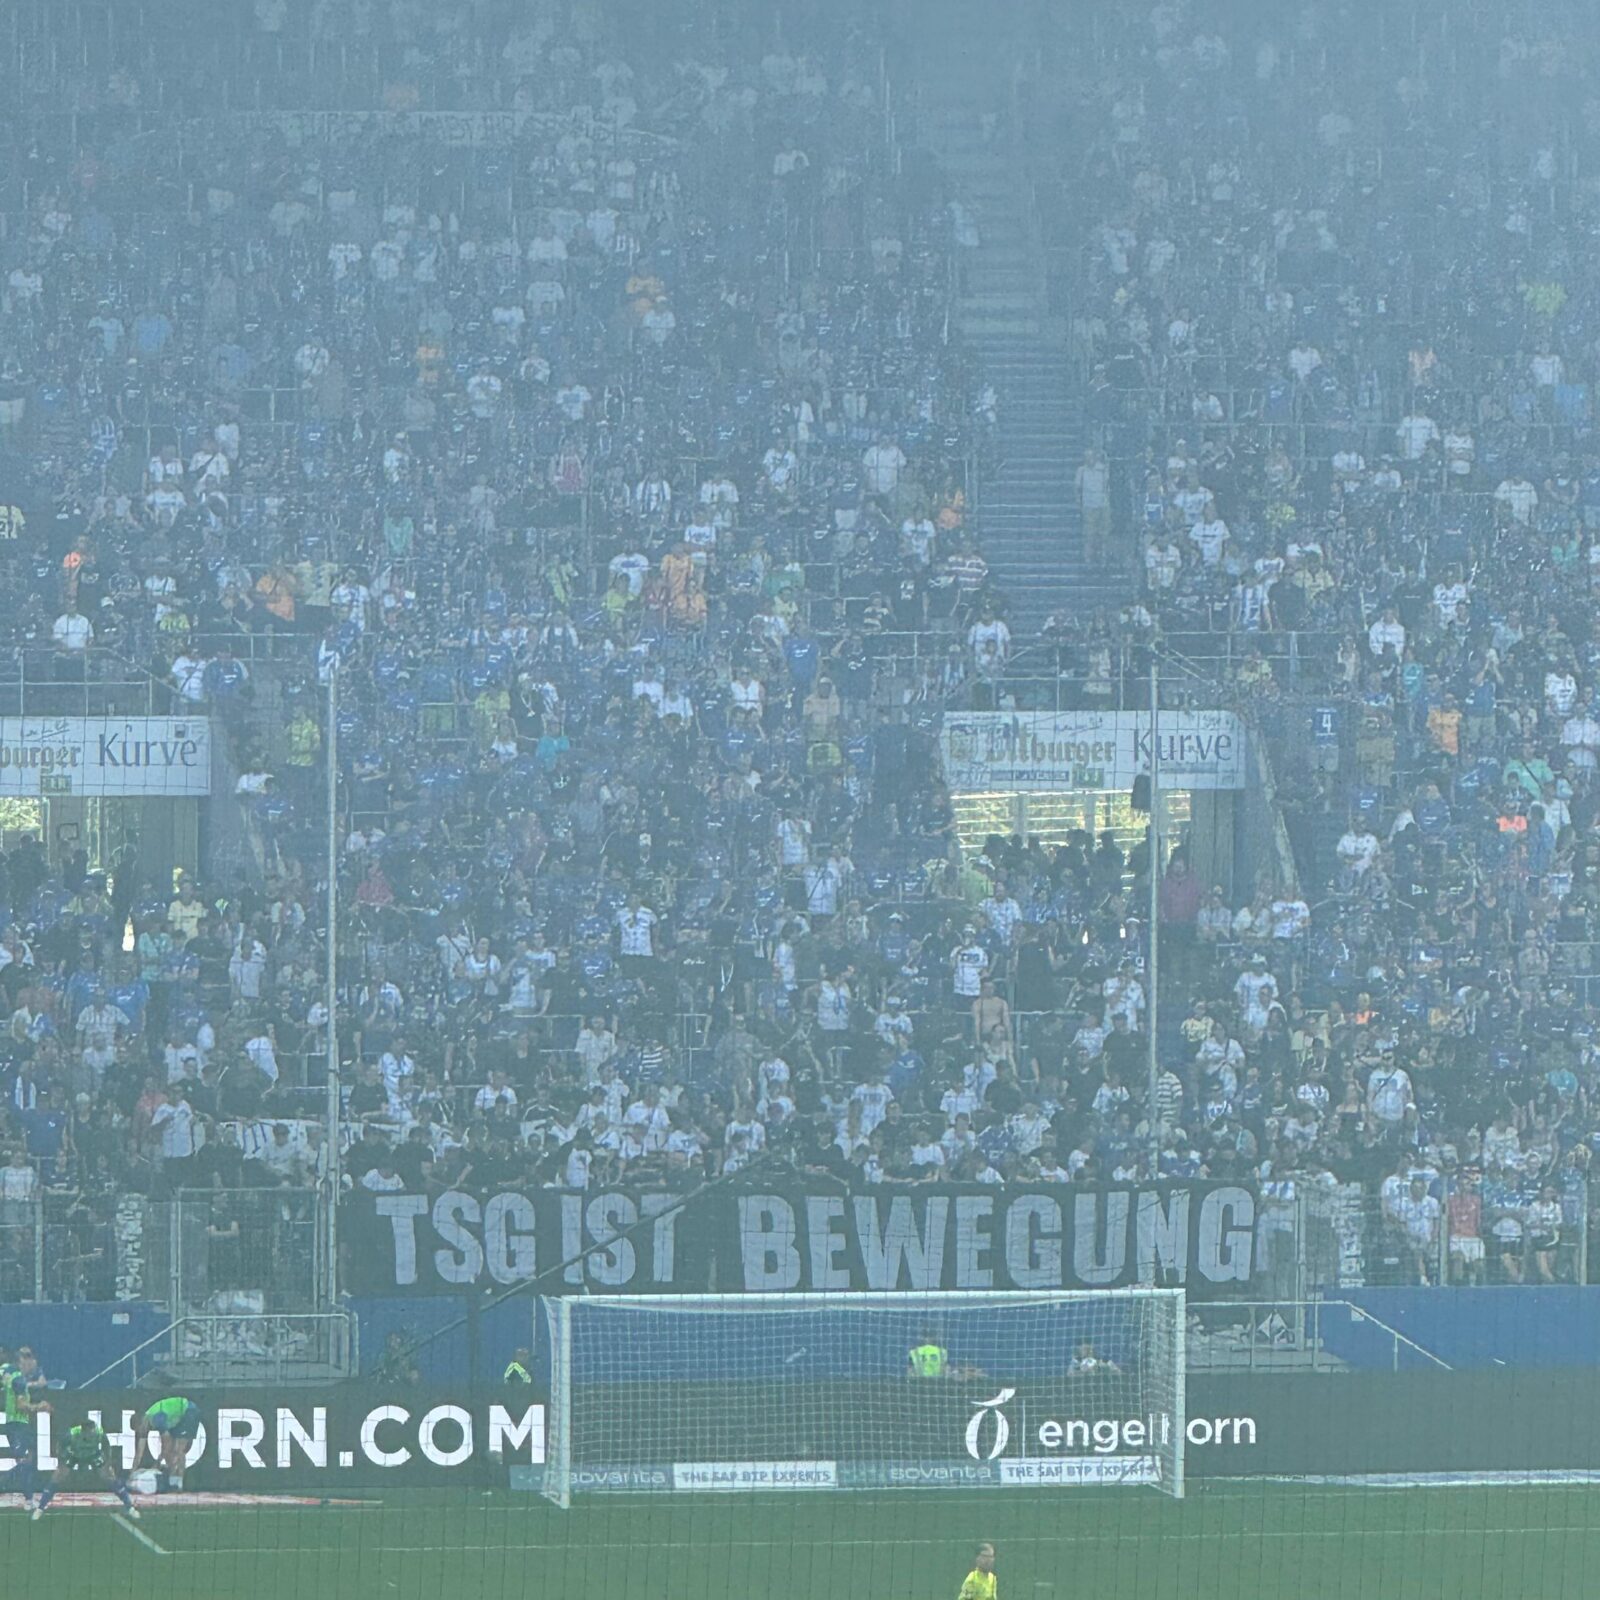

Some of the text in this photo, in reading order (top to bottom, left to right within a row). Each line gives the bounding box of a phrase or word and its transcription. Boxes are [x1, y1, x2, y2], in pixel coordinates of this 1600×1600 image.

[1133, 729, 1231, 762] Kurve
[375, 1190, 538, 1285] TSG
[561, 1193, 686, 1286] IST
[738, 1186, 1255, 1291] BEWEGUNG
[1007, 1466, 1033, 1478] THE
[1067, 1466, 1092, 1477] BTP
